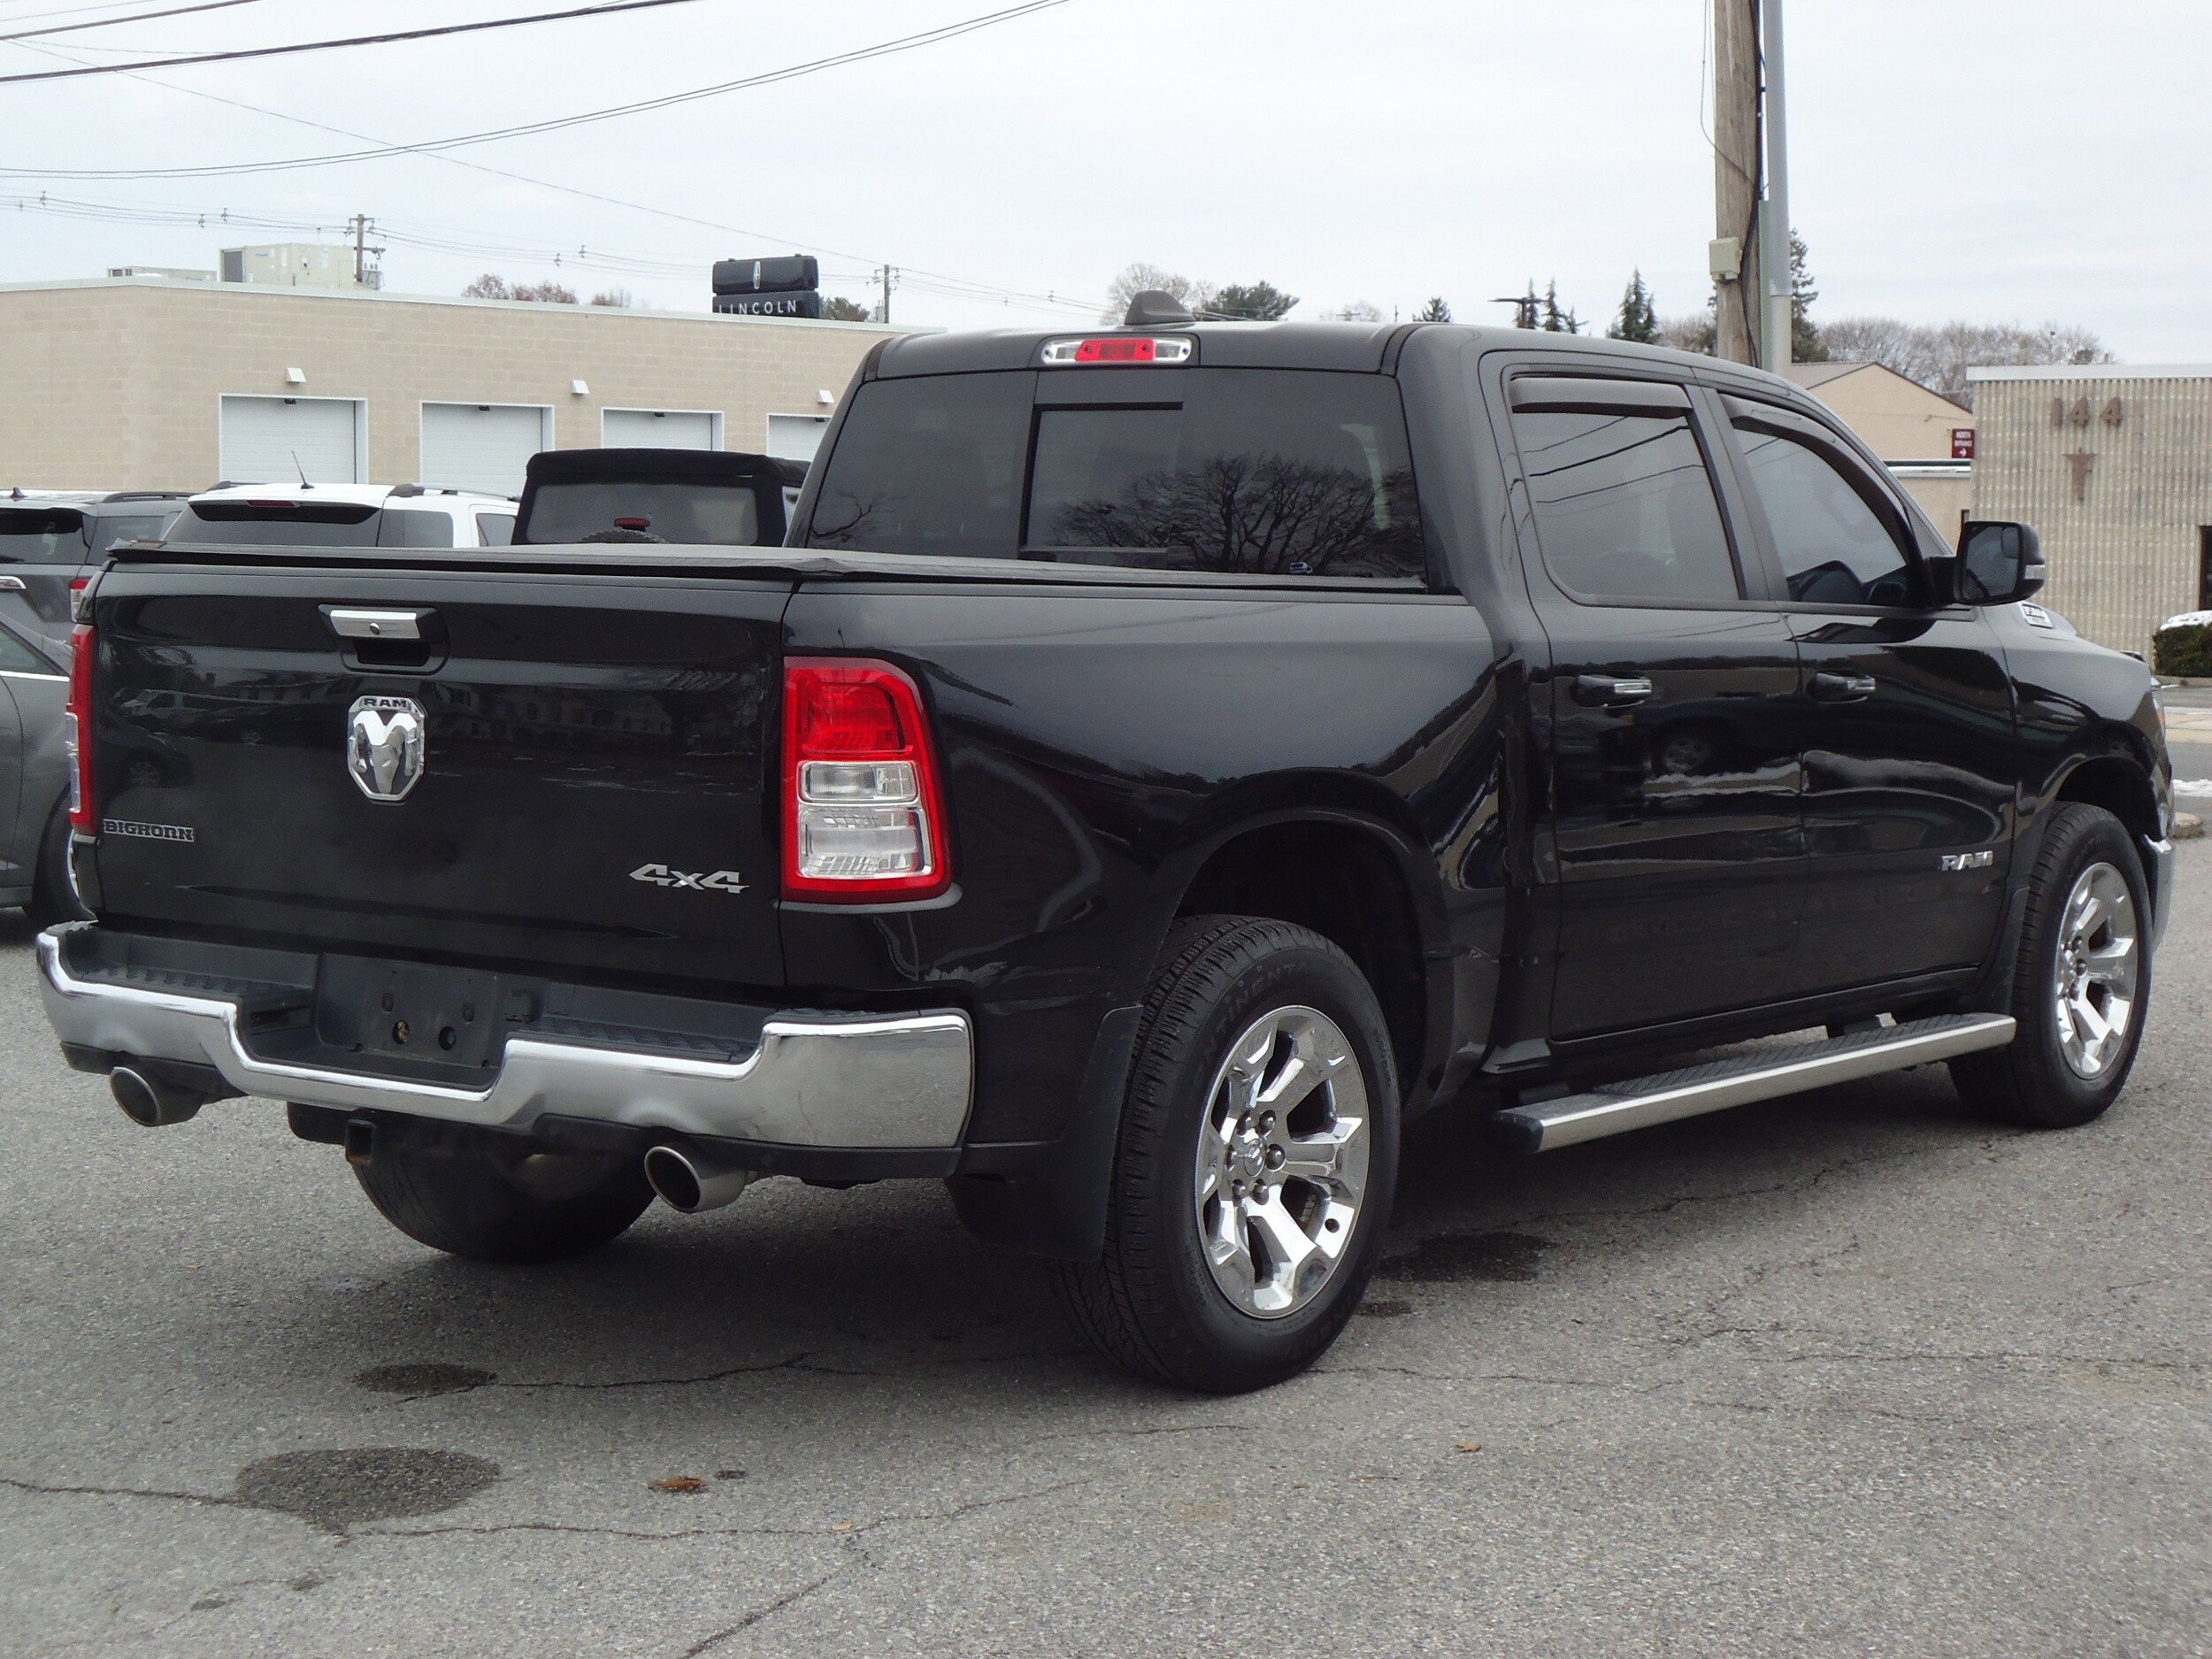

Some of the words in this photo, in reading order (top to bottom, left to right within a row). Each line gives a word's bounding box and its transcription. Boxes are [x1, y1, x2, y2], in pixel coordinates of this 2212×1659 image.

[718, 299, 797, 315] LINCOLN
[2052, 397, 2124, 428] 144
[363, 697, 408, 709] RAM
[103, 818, 195, 842] BIGHORN
[628, 863, 750, 894] 4x4
